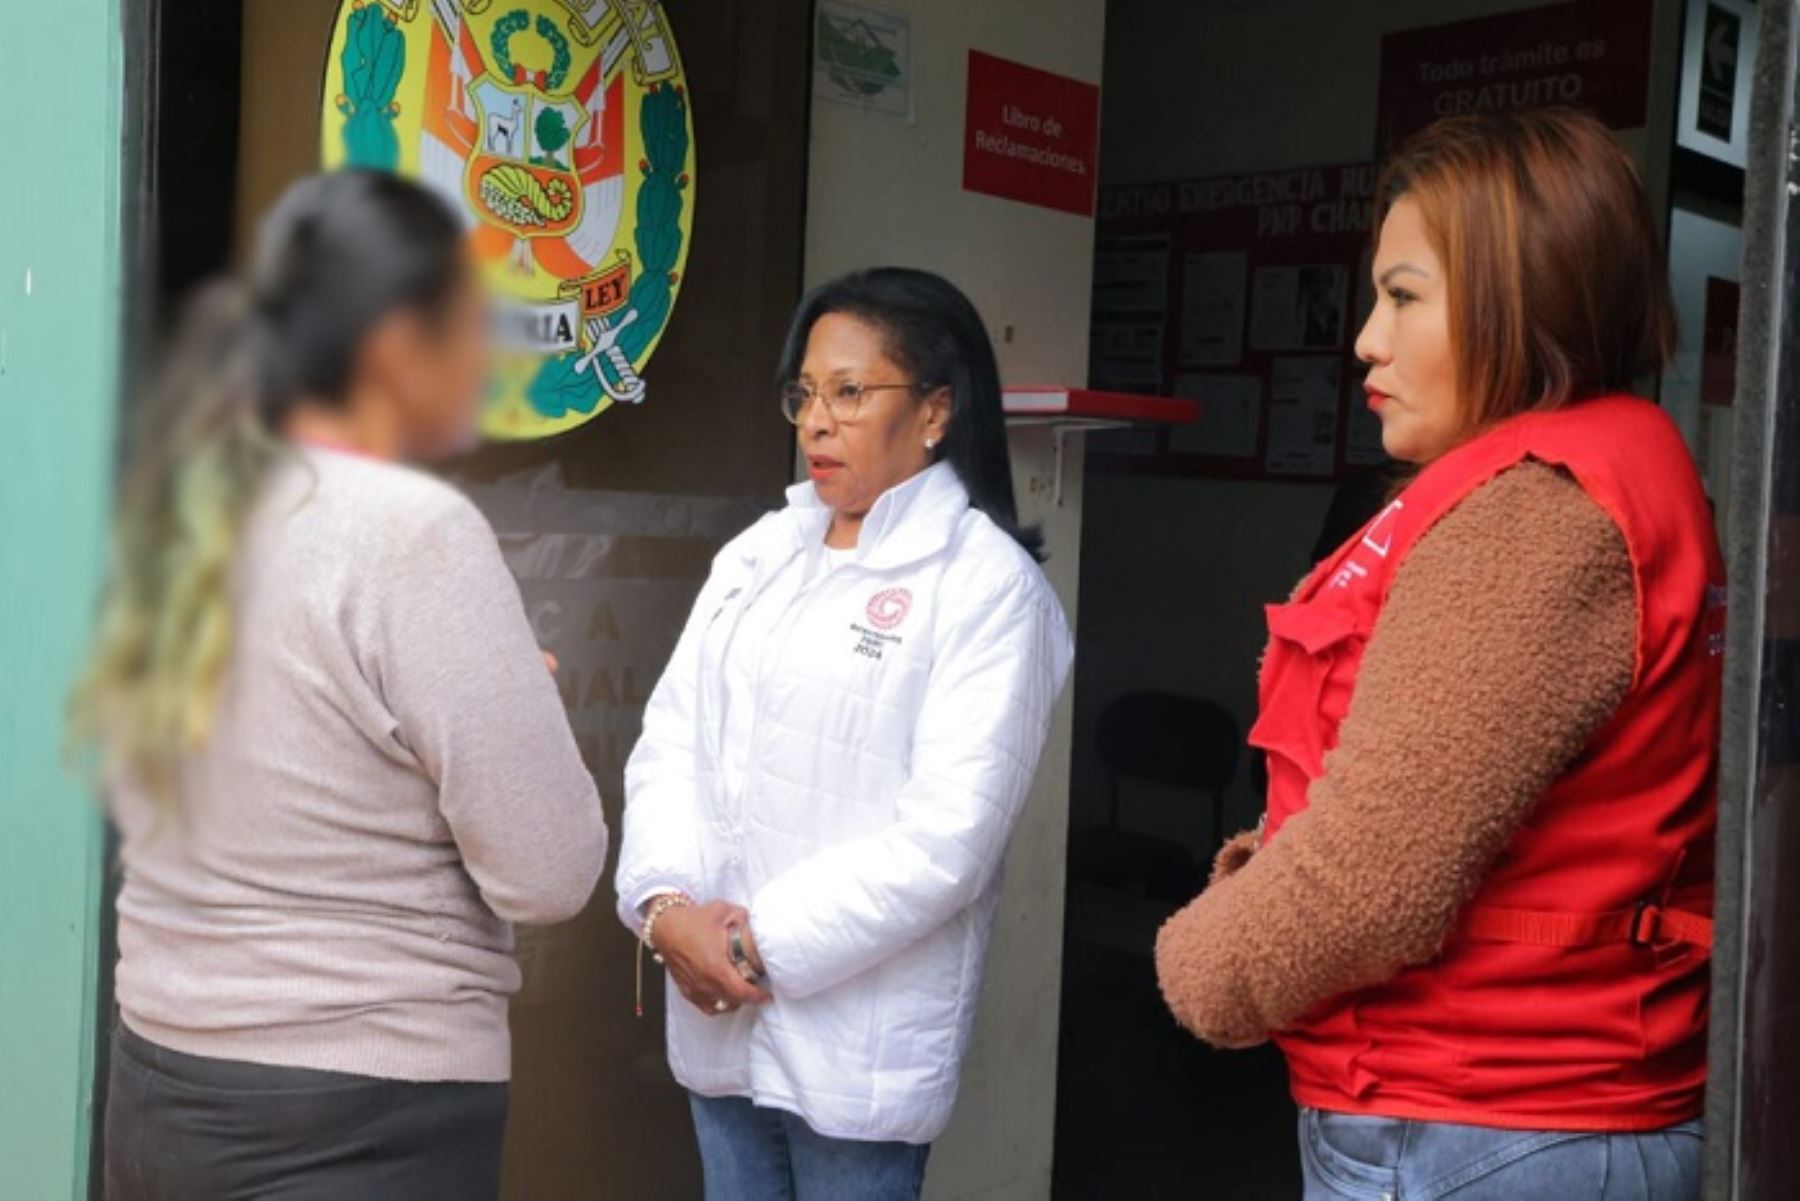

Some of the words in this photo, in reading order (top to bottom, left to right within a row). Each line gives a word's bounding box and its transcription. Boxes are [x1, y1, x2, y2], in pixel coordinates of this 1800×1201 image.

[1417, 56, 1475, 83] Todo
[1479, 42, 1568, 77] trámite
[1574, 37, 1606, 61] es
[1432, 72, 1582, 116] GRATUITO
[1002, 103, 1041, 132] Libro
[1042, 115, 1063, 138] de
[975, 129, 1086, 175] Reclamaciones
[1178, 169, 1326, 213] EMERGENCIA
[1339, 166, 1377, 200] MU
[1256, 203, 1303, 238] PNP
[584, 273, 625, 310] LEY
